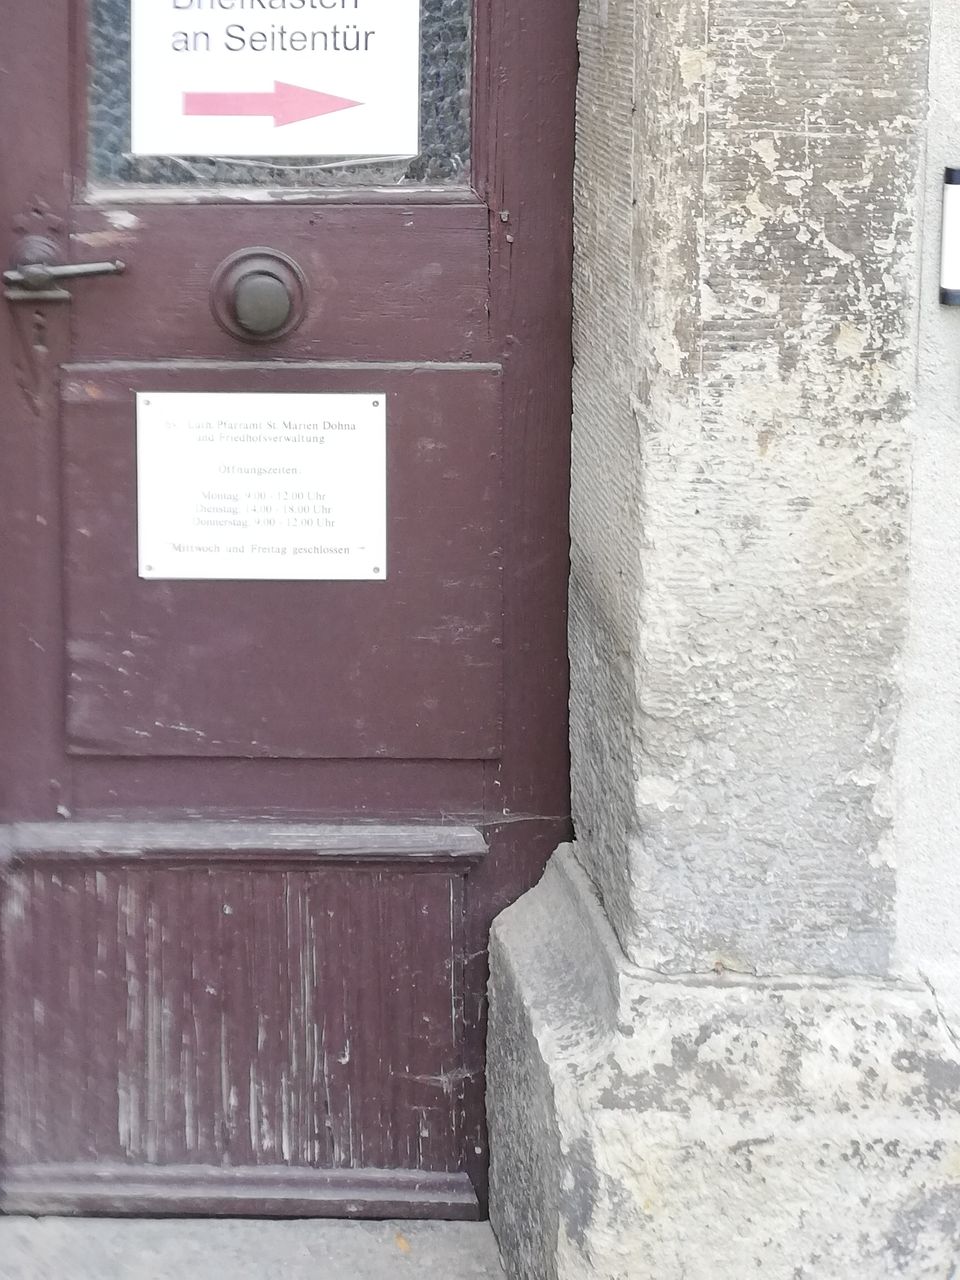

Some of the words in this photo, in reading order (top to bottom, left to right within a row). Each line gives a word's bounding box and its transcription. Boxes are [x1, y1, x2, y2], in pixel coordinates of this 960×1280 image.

[171, 29, 210, 52] an
[224, 24, 375, 52] Seitentür
[216, 419, 262, 431] Pfarramt
[282, 419, 319, 431] Marien
[323, 419, 357, 431] Dohna
[219, 431, 325, 445] Friedhofsverwaltung
[307, 490, 327, 501] Uhr
[314, 504, 333, 515] Uhr
[317, 517, 336, 529] Uhr
[170, 542, 220, 552] Mittwoch
[225, 543, 245, 552] und
[249, 543, 287, 556] Freitag
[292, 544, 350, 556] geschlossen
